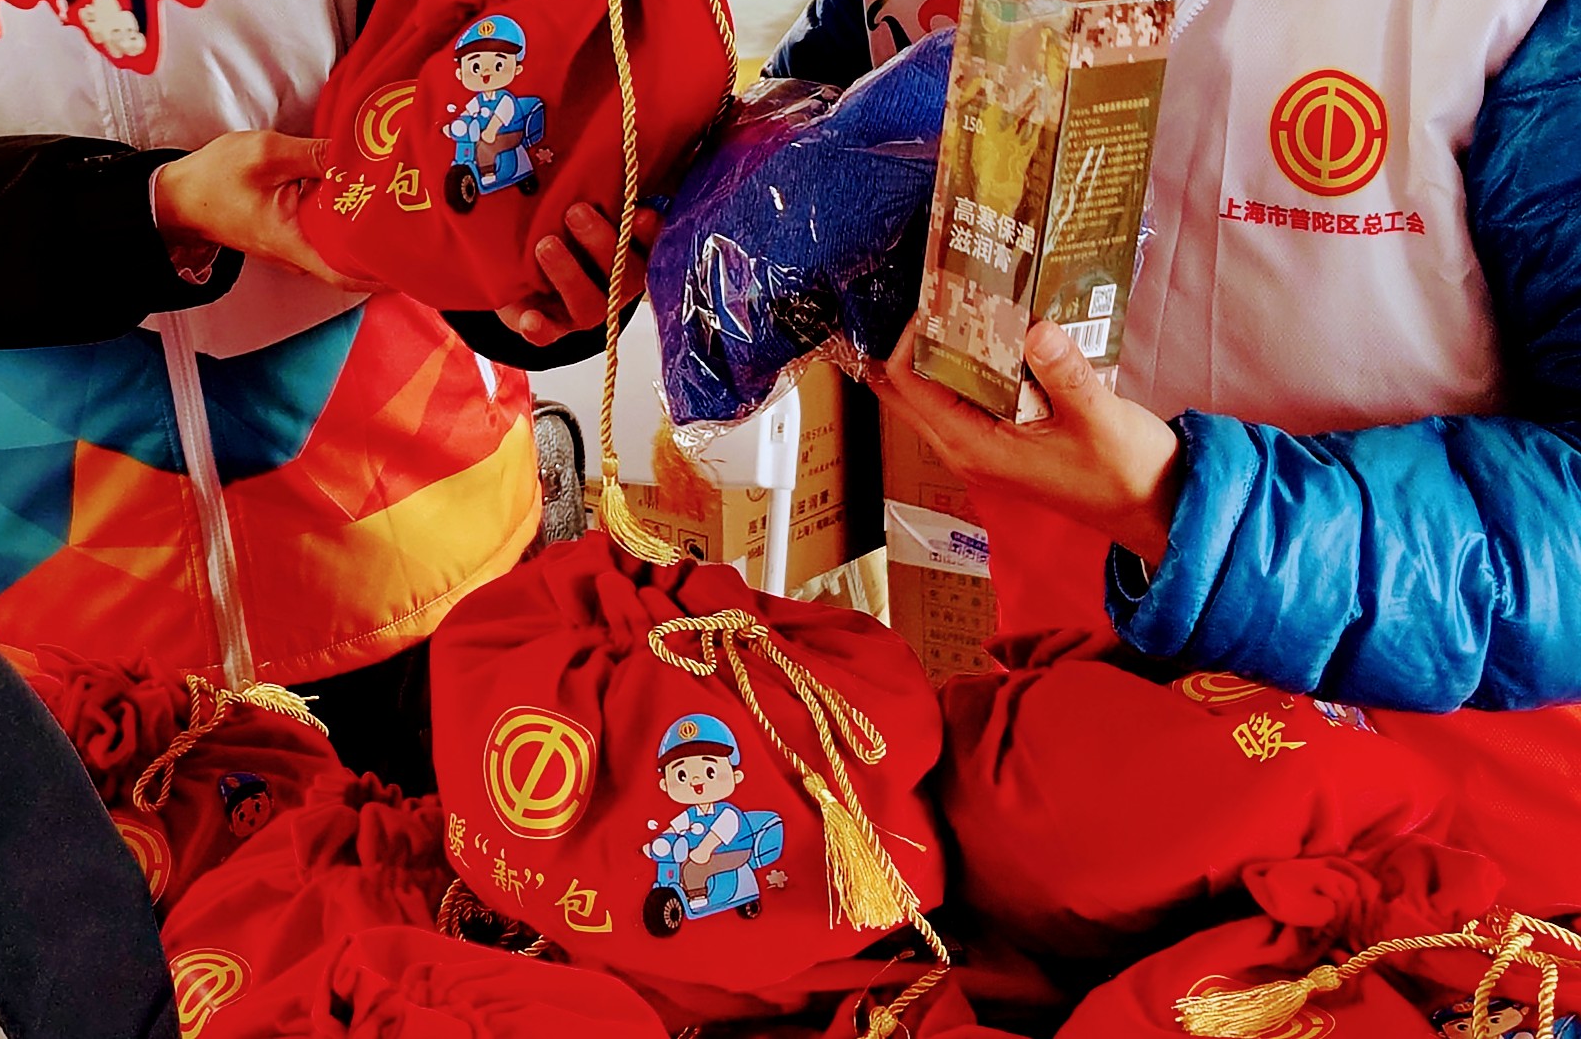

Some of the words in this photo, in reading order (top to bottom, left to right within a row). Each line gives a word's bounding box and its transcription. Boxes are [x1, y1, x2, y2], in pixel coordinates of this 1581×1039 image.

[953, 196, 1036, 255] 高寒保湿
[1219, 197, 1426, 236] 上海市普陀区总工会
[1232, 712, 1308, 763] 暖
